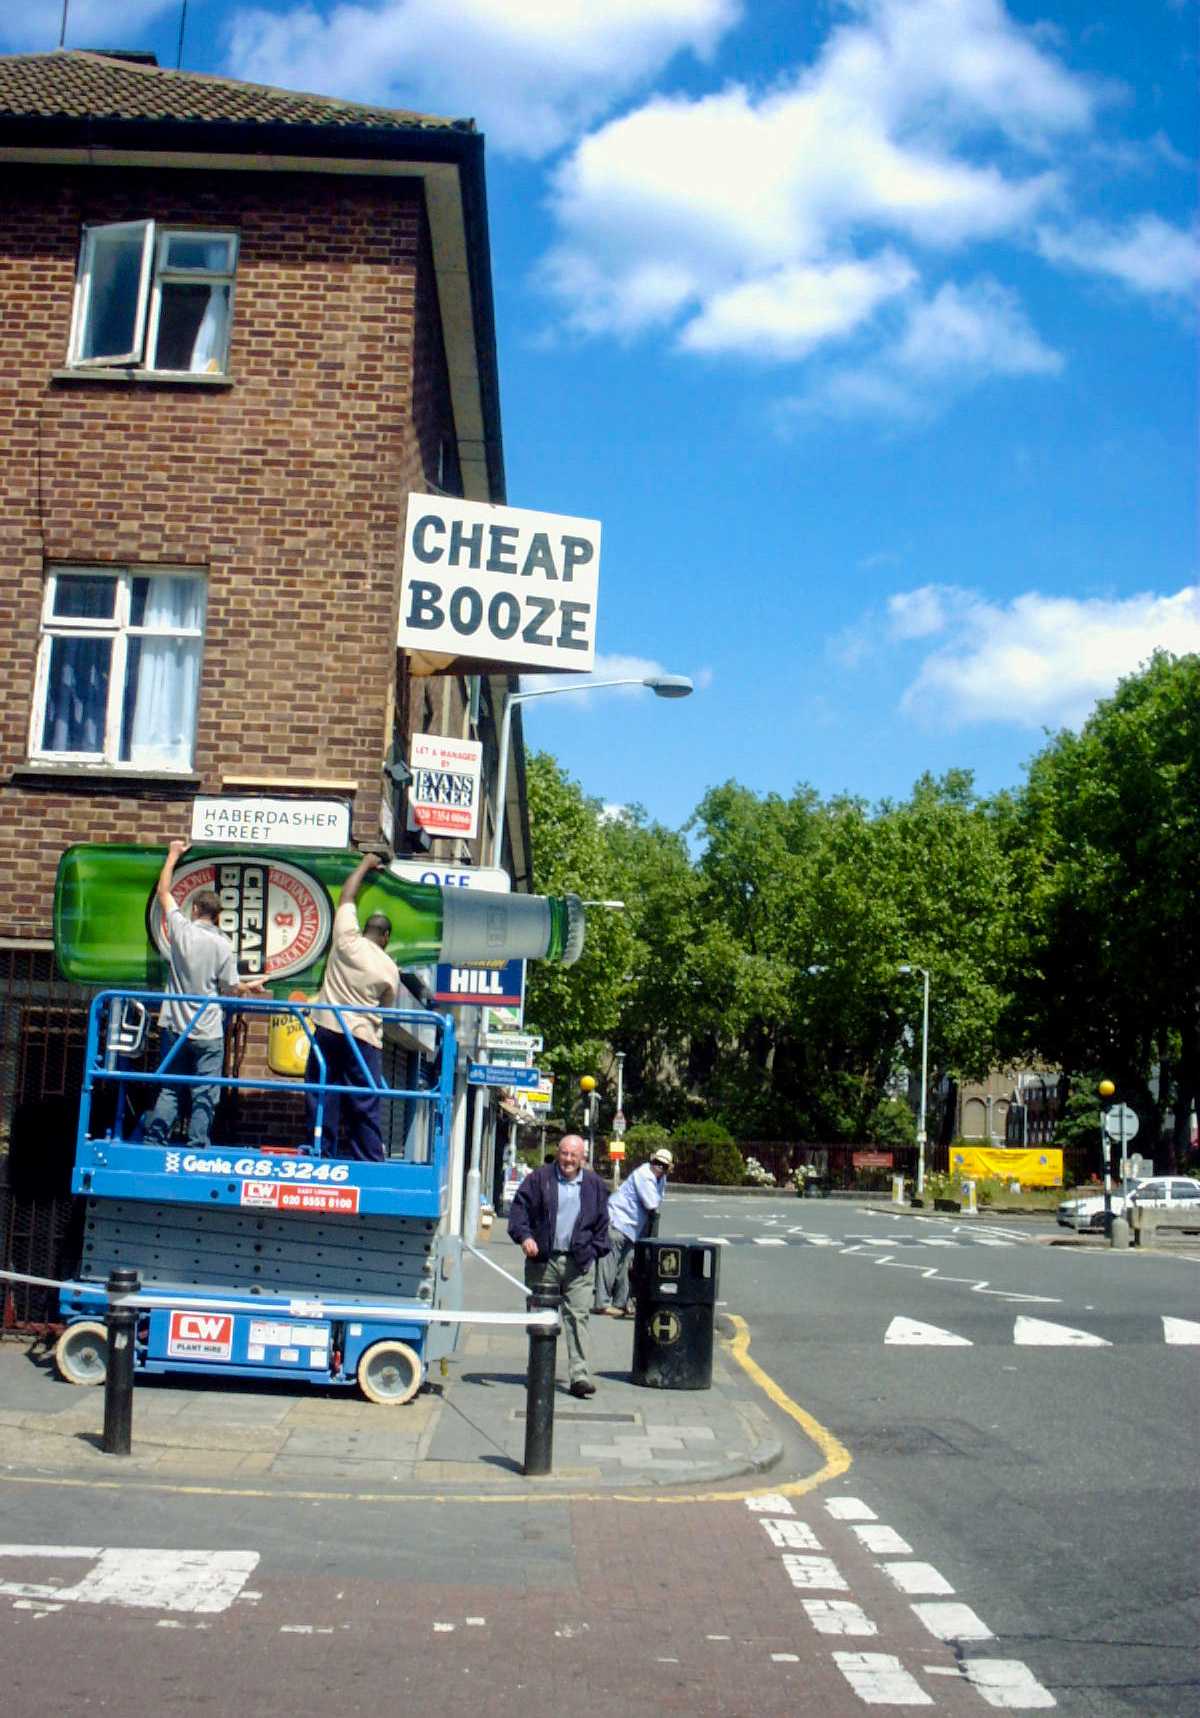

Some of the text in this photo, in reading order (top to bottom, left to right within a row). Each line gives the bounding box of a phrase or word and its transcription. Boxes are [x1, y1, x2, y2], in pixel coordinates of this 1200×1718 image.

[411, 514, 594, 582] CHEAP
[405, 579, 591, 651] BOOZE
[415, 745, 429, 756] LET
[440, 749, 477, 762] MANAGED
[419, 768, 473, 793] EVANS
[418, 786, 472, 807] BAKER
[204, 808, 338, 827] HABERDASHER
[203, 823, 272, 840] STREET
[219, 865, 241, 957] BOOZ
[240, 867, 264, 973] CHEAP
[449, 968, 503, 994] HILL
[183, 1154, 231, 1174] Genie
[247, 1183, 275, 1198] CW
[179, 1316, 225, 1340] CW
[176, 1342, 222, 1353] PLANT HIRE
